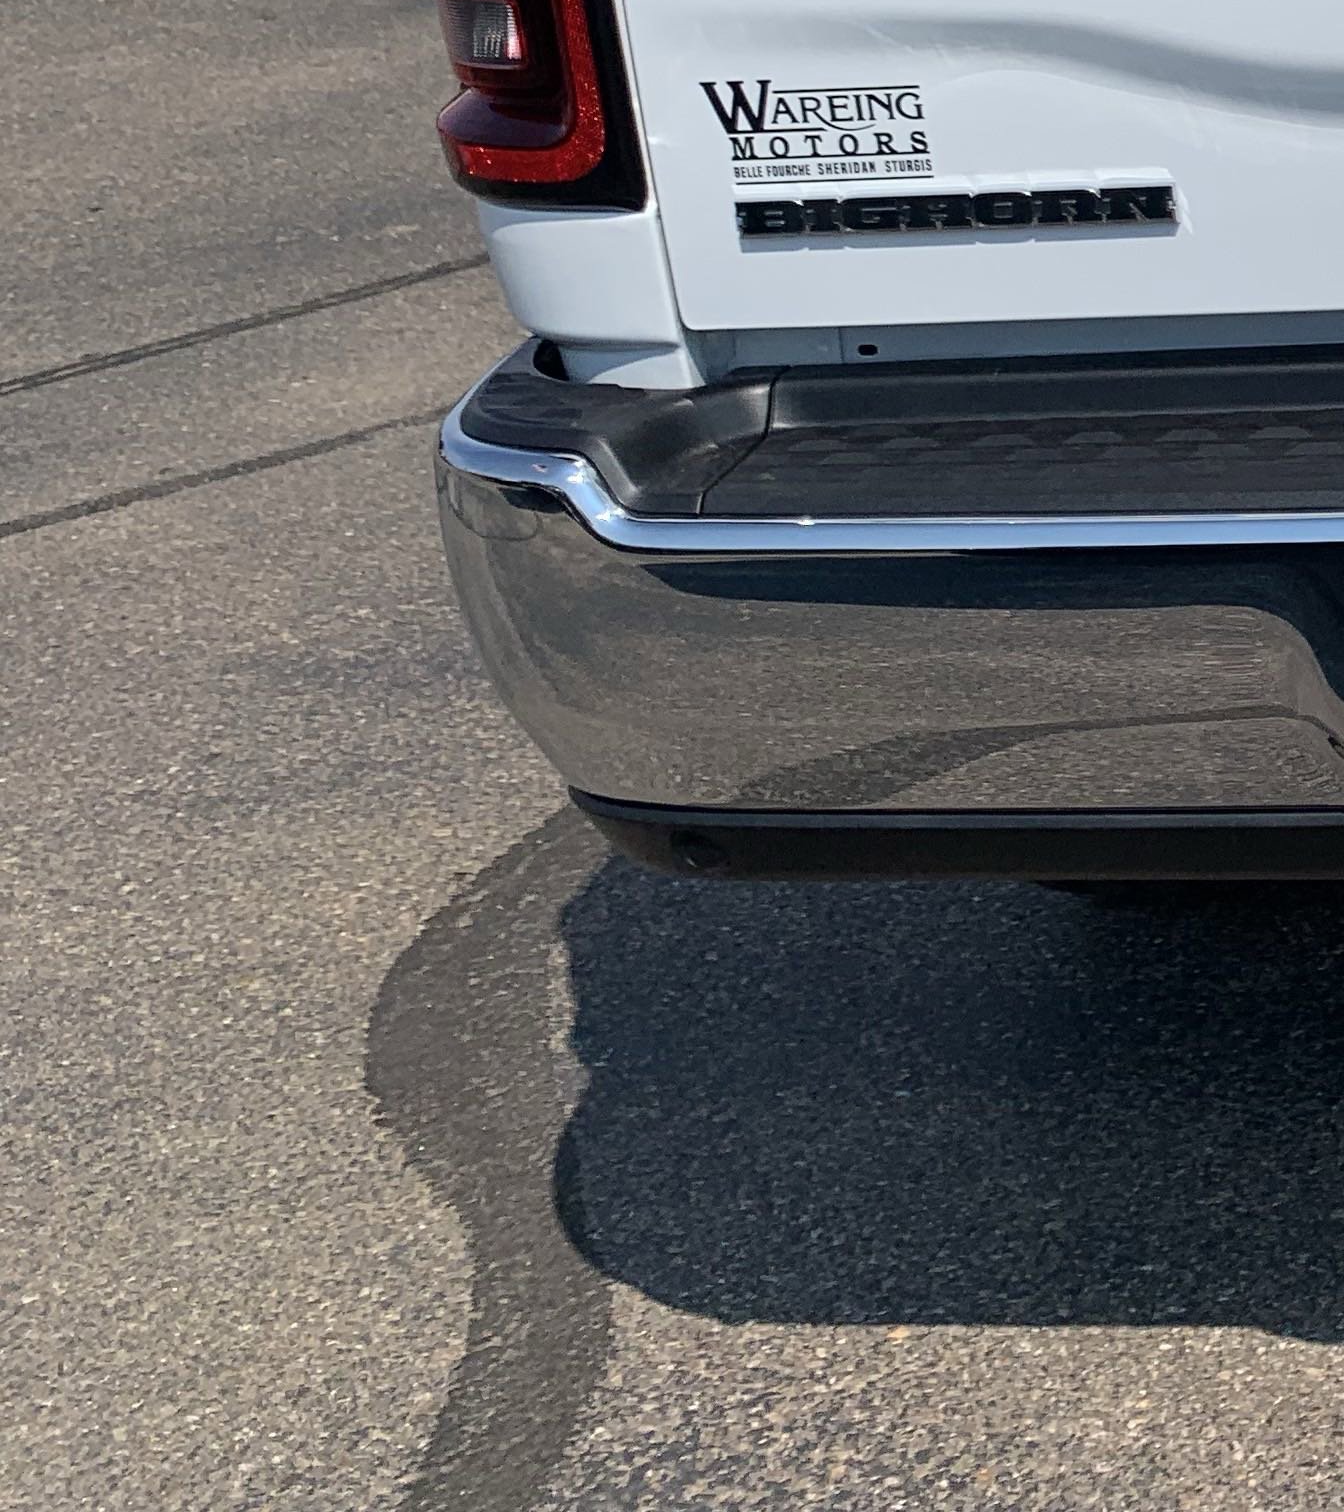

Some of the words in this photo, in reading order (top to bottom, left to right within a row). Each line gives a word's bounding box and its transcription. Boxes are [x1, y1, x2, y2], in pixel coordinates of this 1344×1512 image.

[731, 131, 929, 161] MOTORS
[733, 166, 764, 178] BELLE
[766, 164, 811, 177] FOURCHE
[818, 161, 876, 175] SHERIDAN
[886, 159, 933, 172] STURGIS
